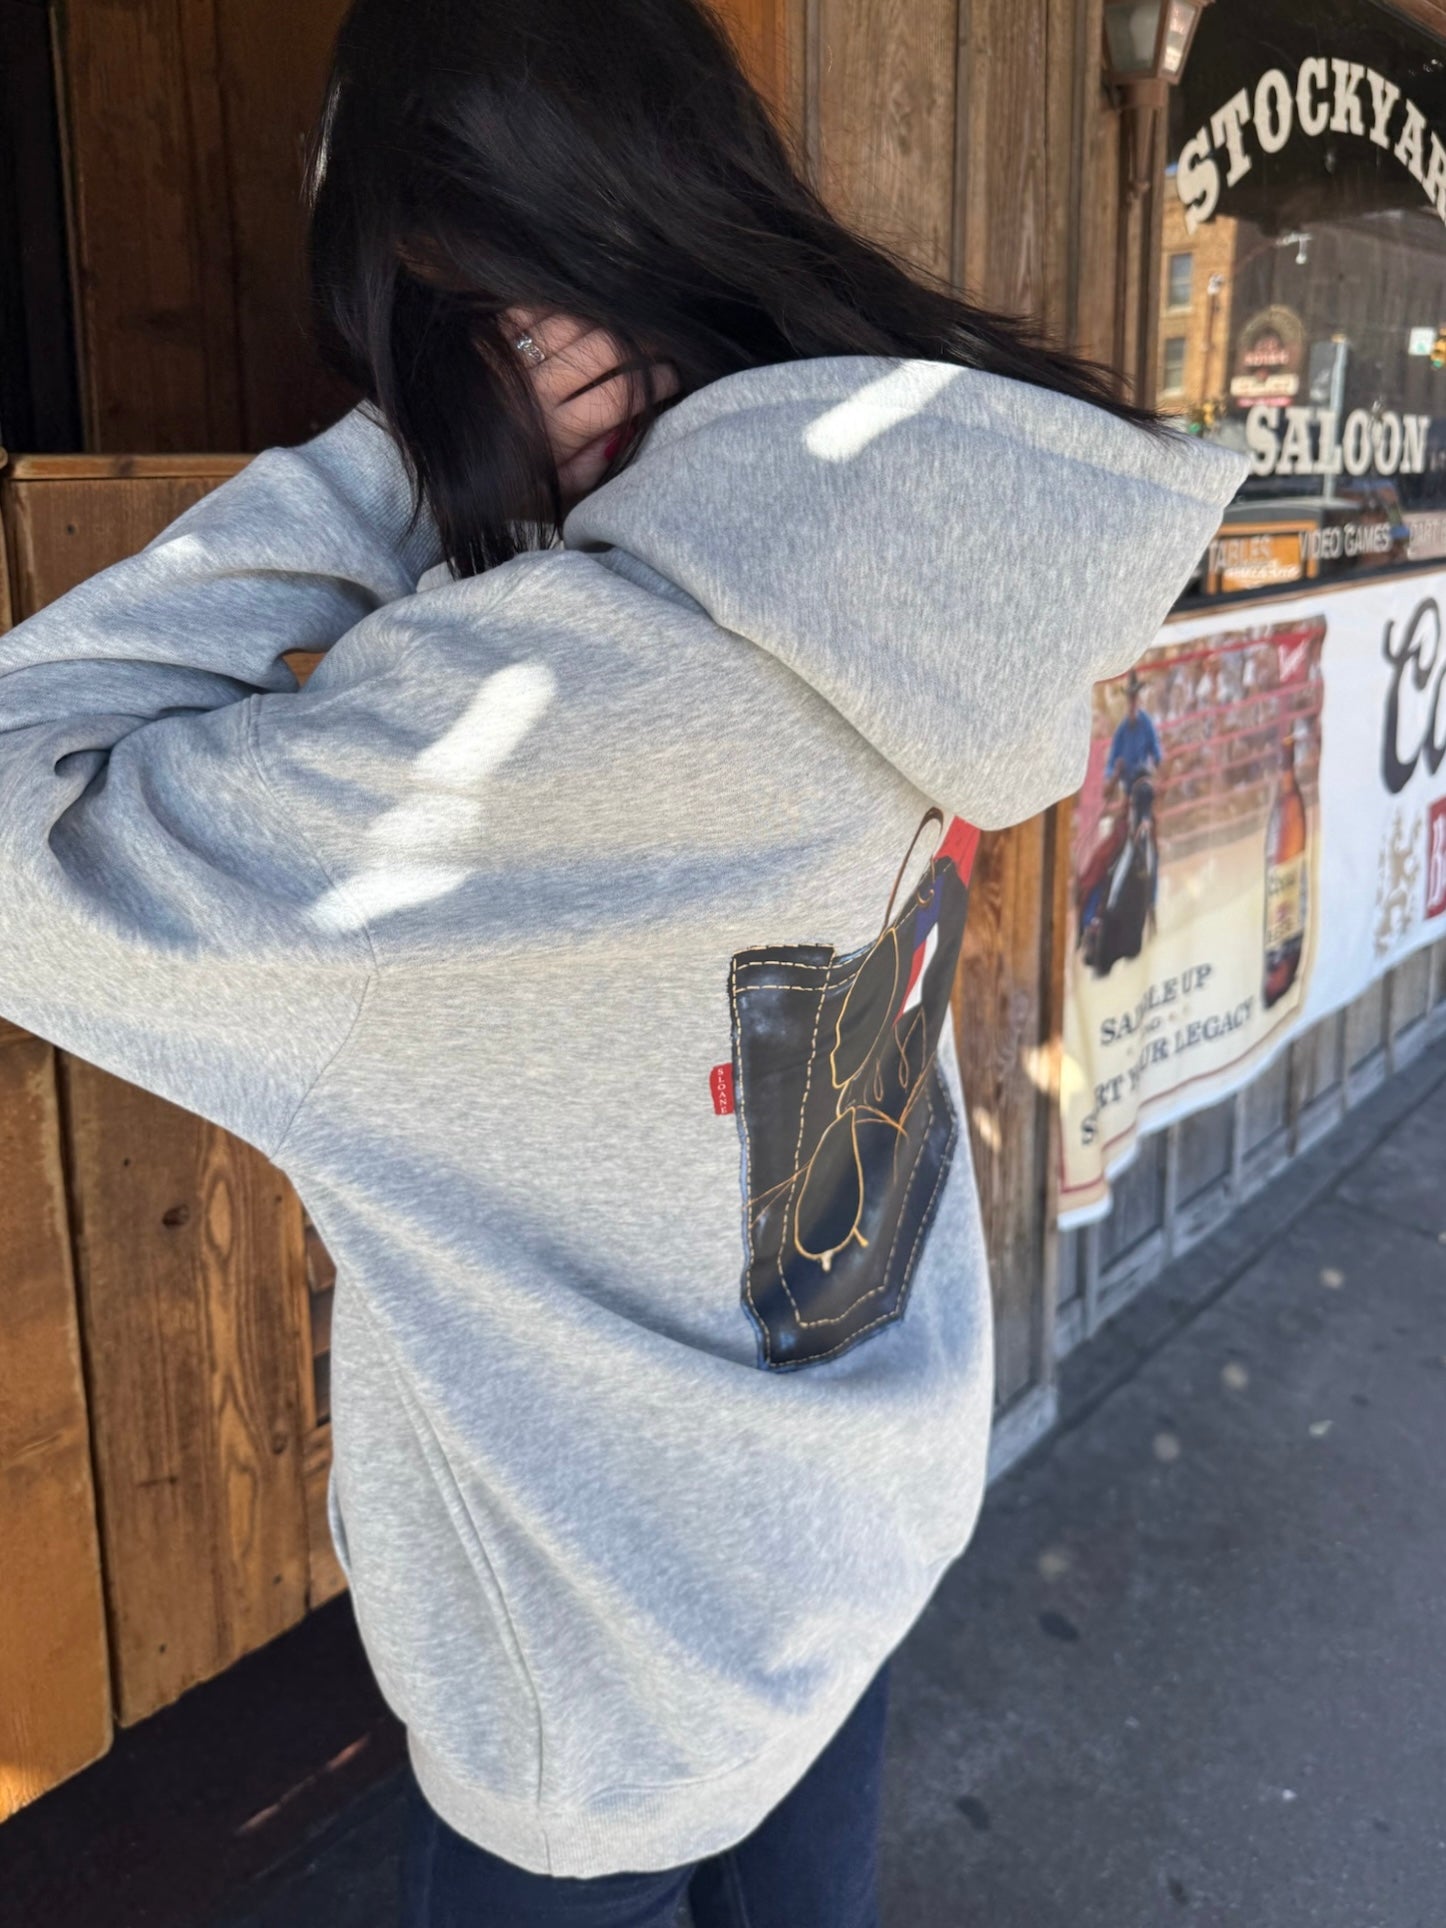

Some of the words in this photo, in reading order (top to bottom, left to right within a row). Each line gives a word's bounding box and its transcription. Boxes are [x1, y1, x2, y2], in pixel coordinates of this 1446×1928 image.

[1246, 405, 1430, 476] SALOON
[1299, 526, 1341, 562] VIDEO
[1344, 521, 1391, 557] GAMES
[1181, 963, 1212, 995] UP
[1128, 1037, 1168, 1091] YUR
[1174, 996, 1254, 1054] LEGACY
[717, 1067, 727, 1114] SLOANE
